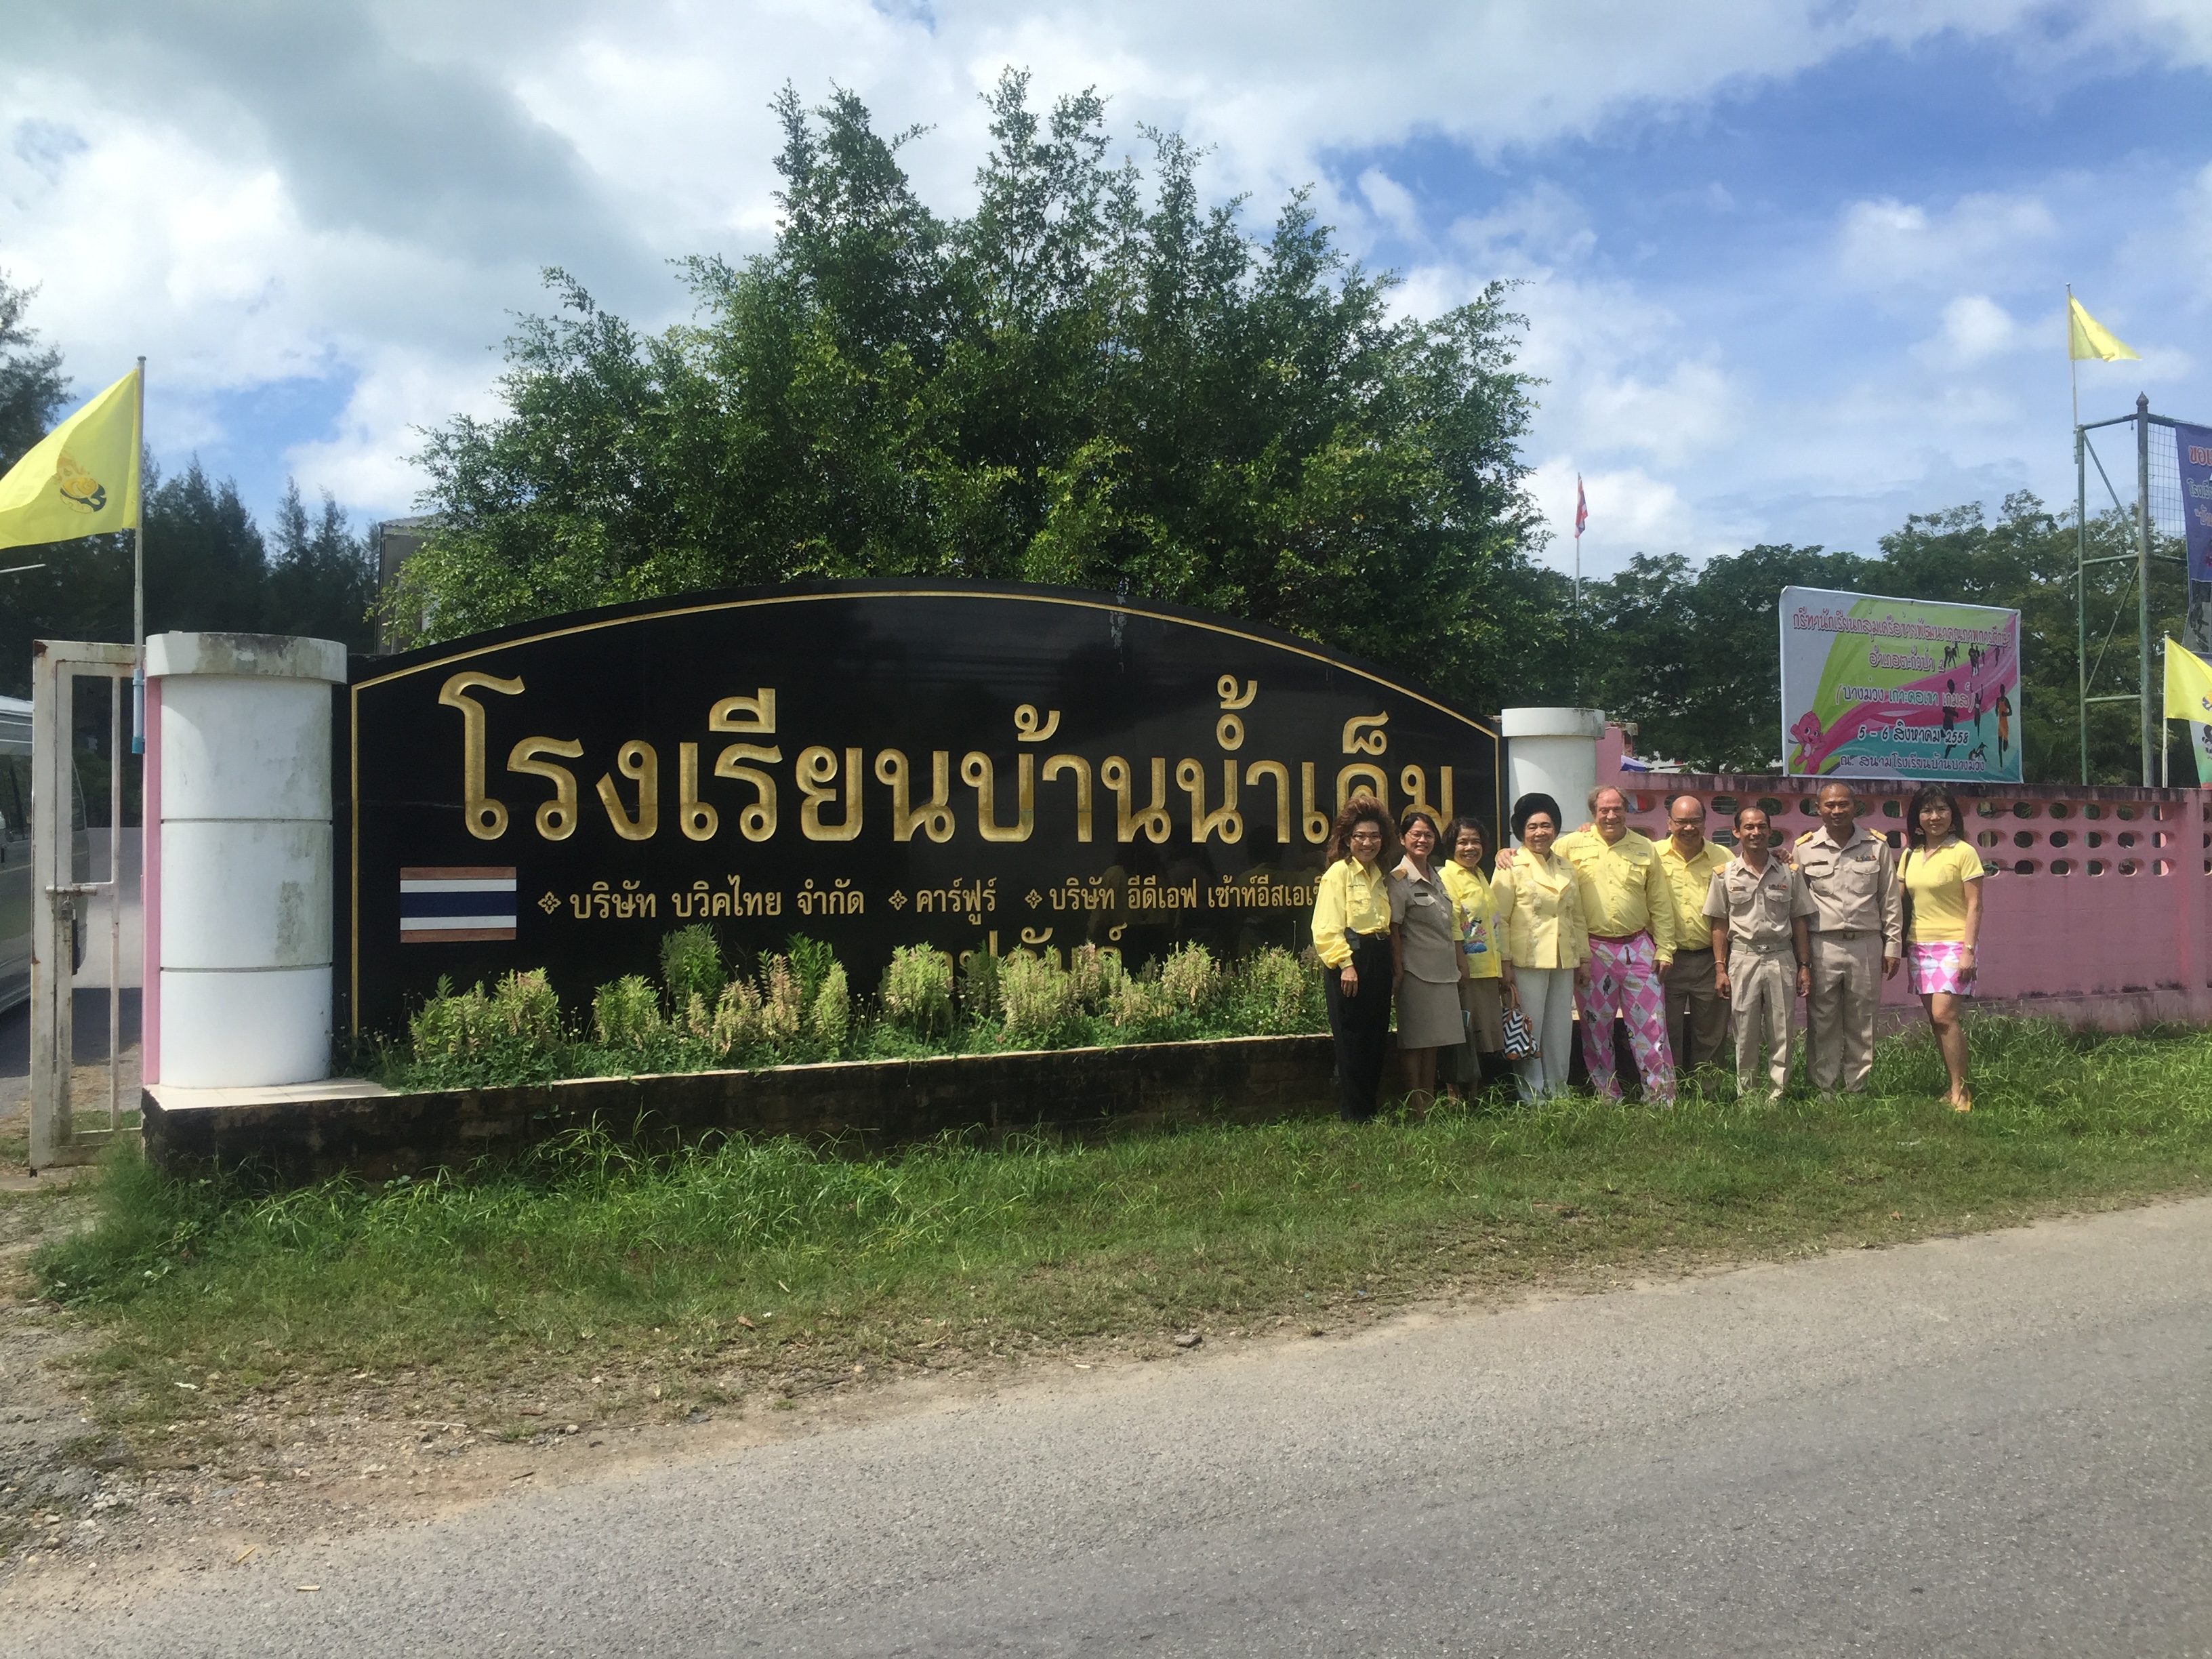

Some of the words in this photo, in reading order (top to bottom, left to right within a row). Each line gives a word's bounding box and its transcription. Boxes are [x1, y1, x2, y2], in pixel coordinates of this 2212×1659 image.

[1869, 645, 1935, 671] อำเภอตะกั่วป่า
[1938, 659, 1946, 672] 2
[1858, 726, 1866, 741] 5
[1881, 726, 1889, 741] 6
[1893, 720, 1941, 743] สิงหาคม
[1944, 731, 1969, 744] 2558
[438, 671, 1452, 844] โรงเรียนบ้านน้ำเค็ม
[1840, 755, 1854, 766] ณ.
[570, 880, 656, 919] บริษัท
[672, 874, 781, 918] บวิคไทย
[796, 878, 864, 915] จำกัด
[916, 877, 997, 925] คาร์ฟูร์
[1050, 876, 1115, 910] บริษัท
[1128, 874, 1197, 909] อีดีเอฟ
